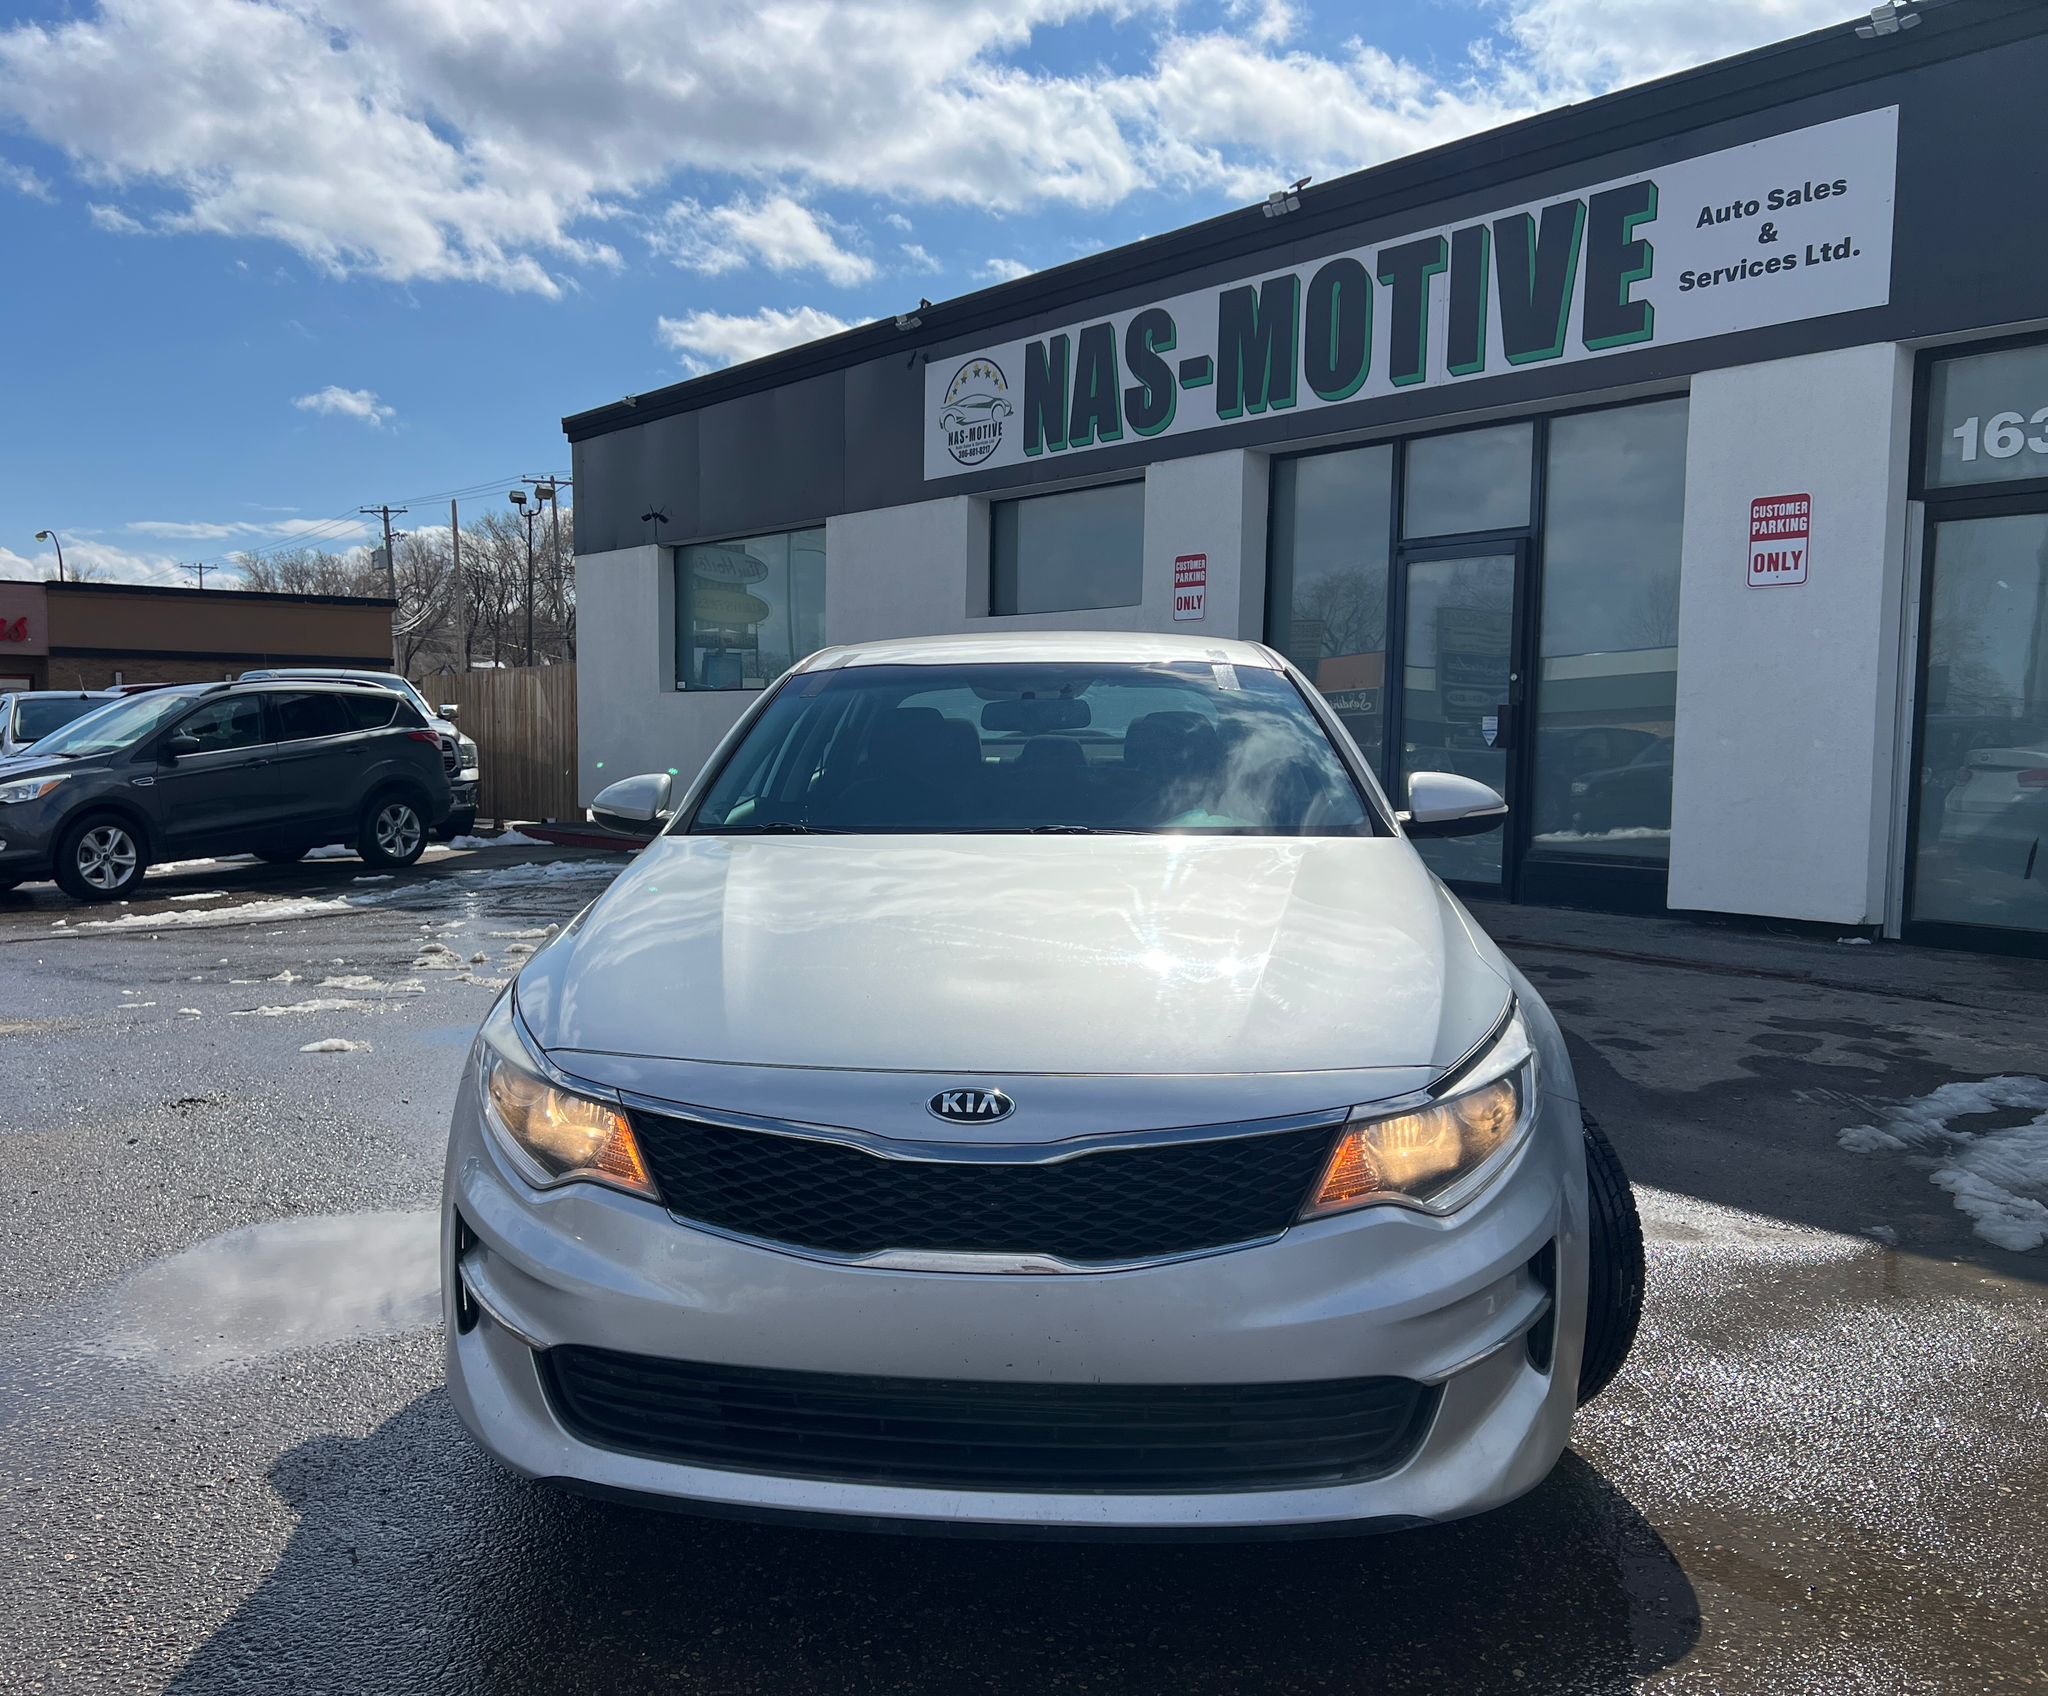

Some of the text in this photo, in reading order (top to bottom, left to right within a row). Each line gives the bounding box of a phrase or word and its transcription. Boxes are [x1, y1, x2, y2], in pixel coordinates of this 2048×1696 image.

[1696, 178, 1848, 228] Auto Sales
[1758, 222, 1778, 244] &
[1678, 236, 1861, 292] Services Ltd.
[1021, 179, 1660, 458] NAS-MOTIVE
[948, 422, 1002, 446] NAS-MOTIVE
[1753, 501, 1808, 519] CUSTOMER
[1752, 517, 1808, 535] PARKING
[1176, 560, 1205, 571] CUSTOMER
[1753, 550, 1803, 573] ONLY
[1176, 571, 1205, 583] PARKING
[1176, 594, 1203, 611] ONLY
[941, 1092, 1000, 1115] KIA
